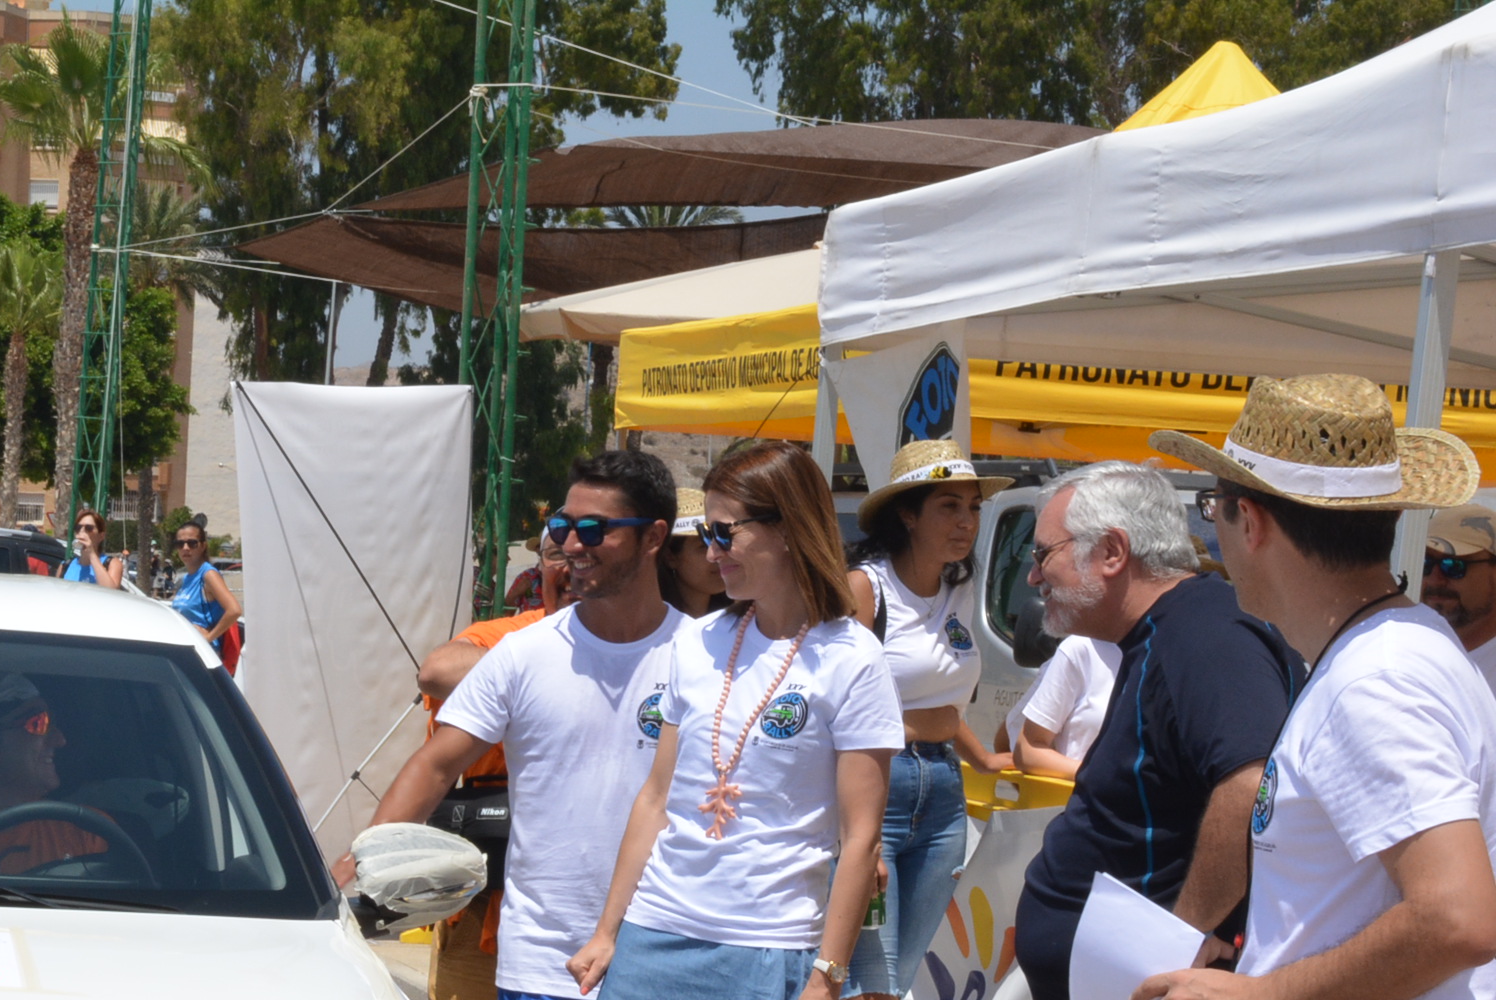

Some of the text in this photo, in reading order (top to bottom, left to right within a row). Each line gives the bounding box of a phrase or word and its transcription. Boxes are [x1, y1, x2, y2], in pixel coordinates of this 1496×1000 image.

[642, 363, 688, 398] PATRONATO
[689, 356, 737, 393] DEPORTIVO
[738, 350, 789, 388] MUNICIPAL
[791, 347, 804, 382] DE
[762, 721, 795, 739] RALLY
[480, 807, 506, 816] Nikon
